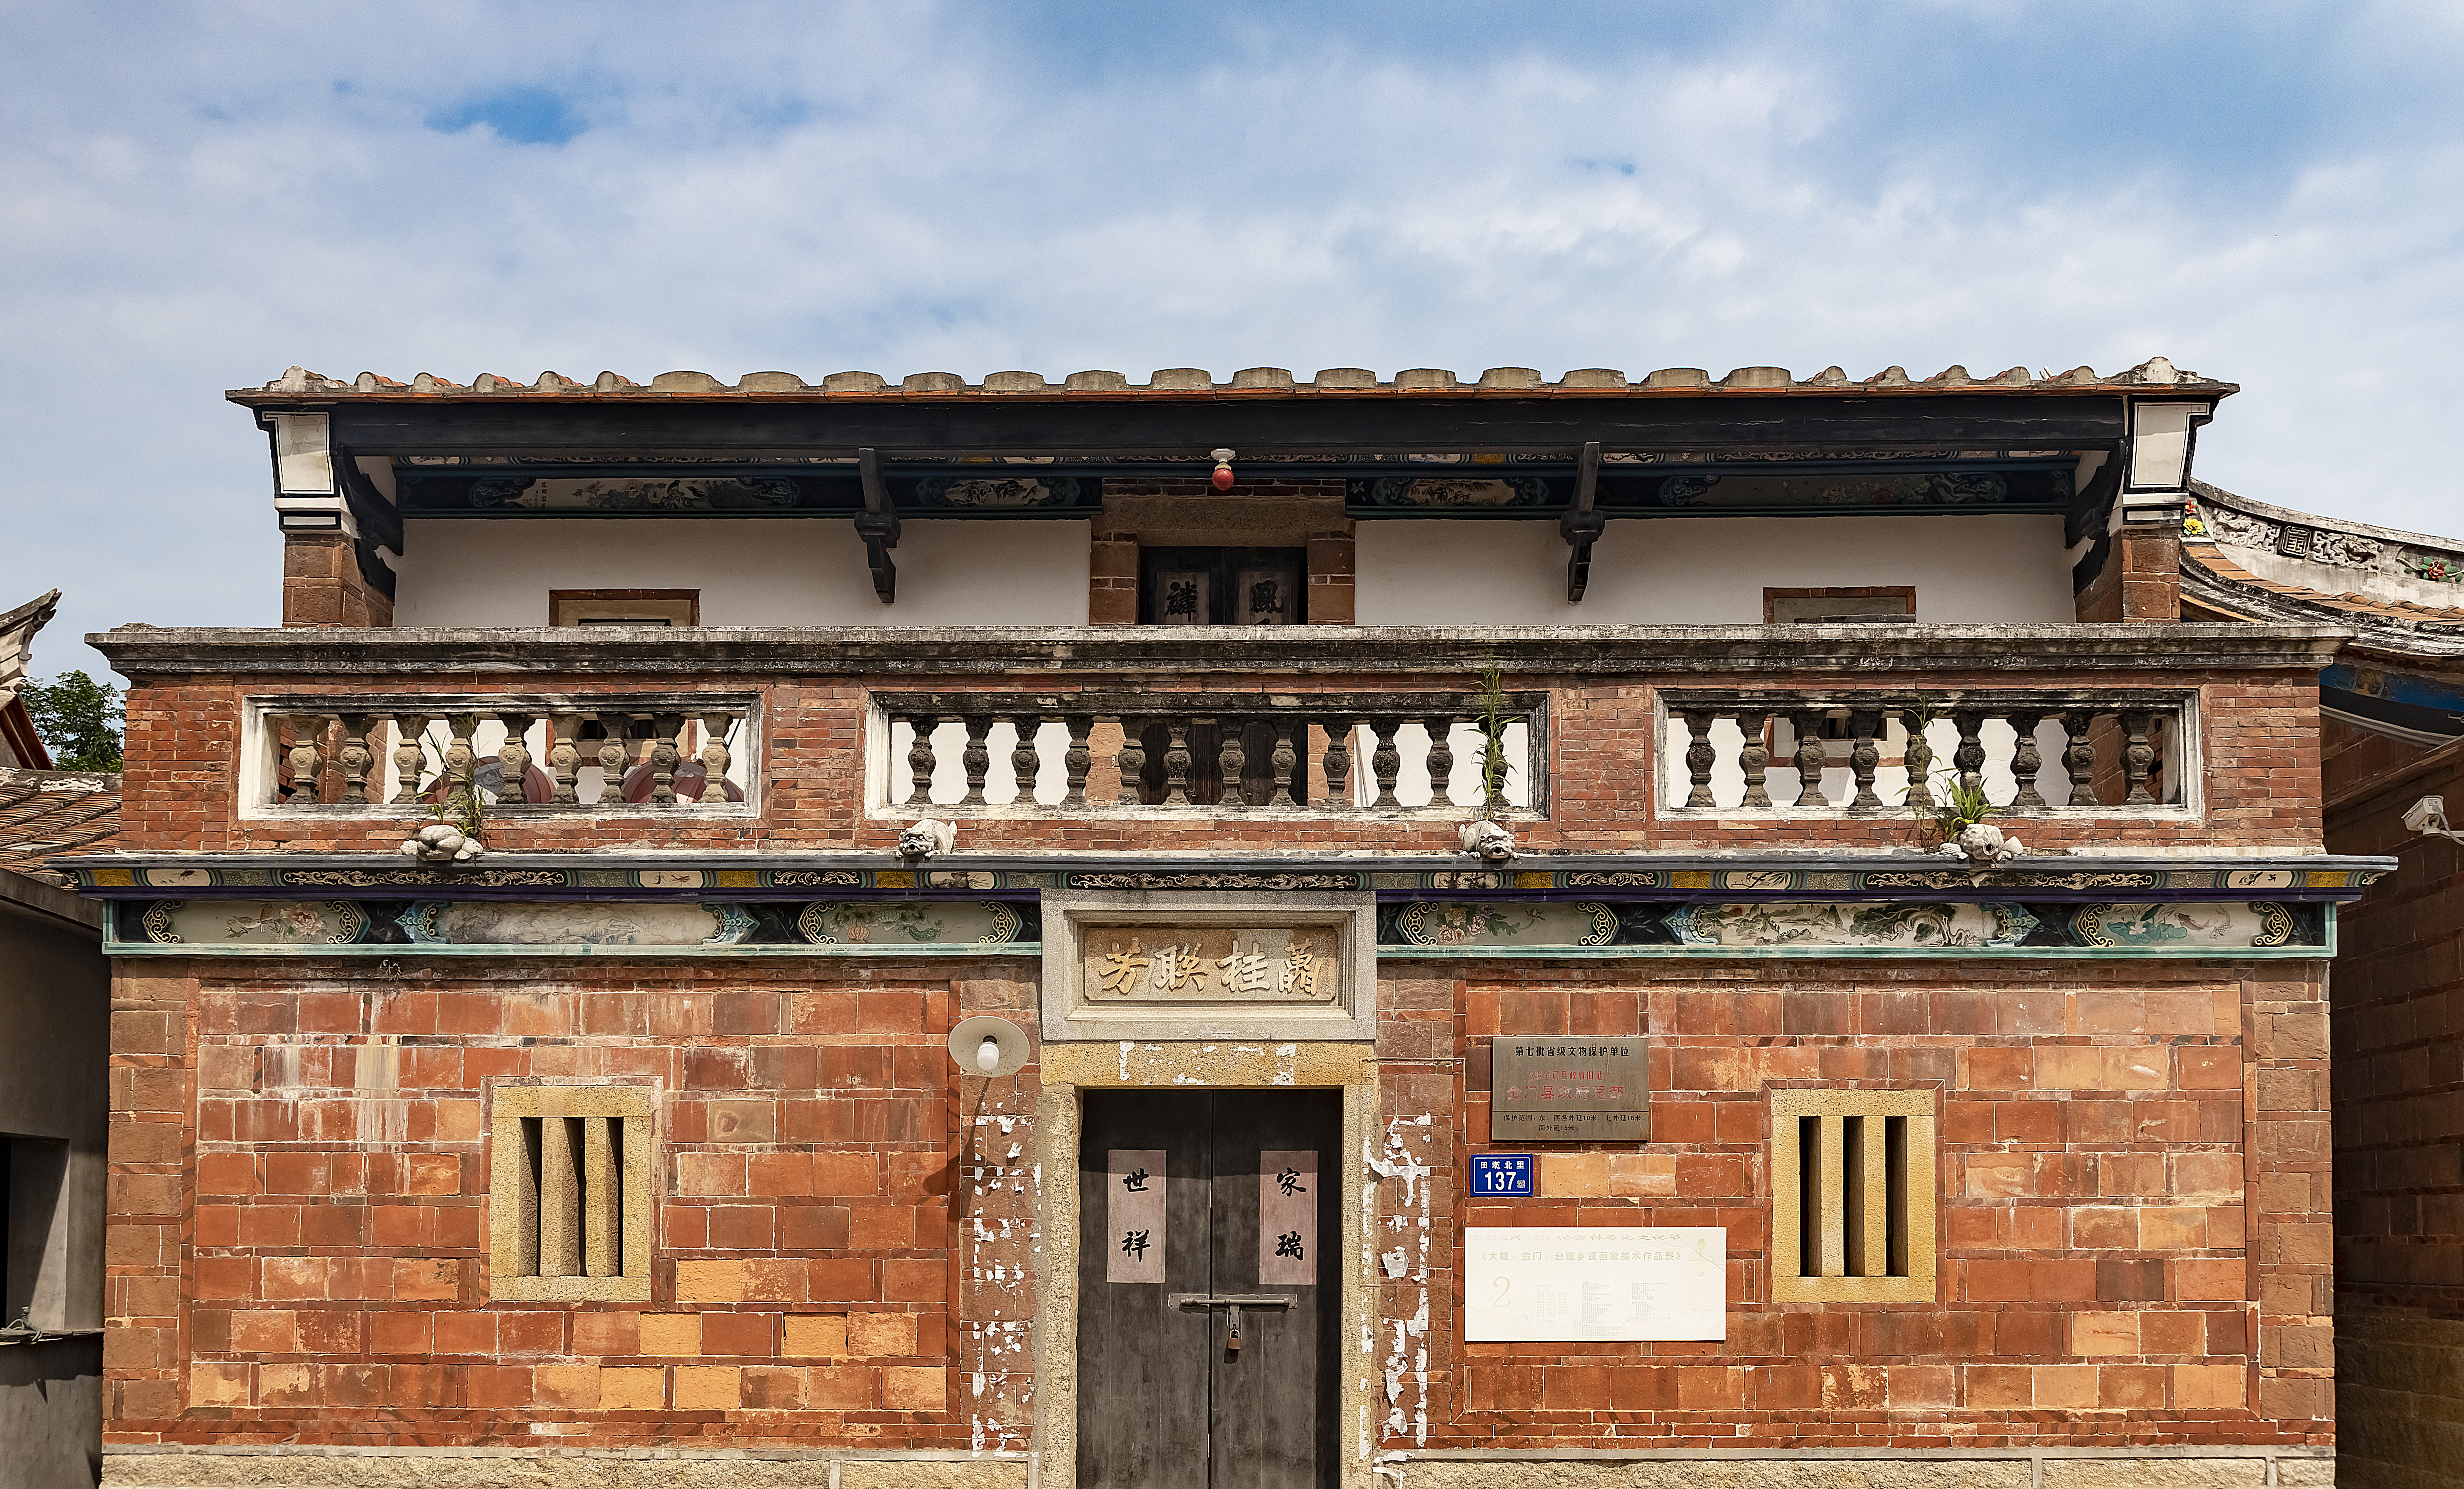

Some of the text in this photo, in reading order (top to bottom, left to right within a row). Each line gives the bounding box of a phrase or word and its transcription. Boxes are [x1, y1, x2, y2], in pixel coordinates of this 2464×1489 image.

[1250, 580, 1284, 625] 鳳
[1515, 1046, 1629, 1057] 第七批省级文物保护单位
[1506, 1085, 1624, 1100] 金门县政府总部
[1480, 1160, 1525, 1170] 田墘北里
[1484, 1171, 1516, 1190] 137
[1121, 1167, 1151, 1263] 世祥
[1274, 1167, 1307, 1261] 家瑞
[1481, 1251, 1682, 1261] 《大嶝、金门、台湾乡贤画家美术作品展》
[1492, 1276, 1512, 1308] 2
